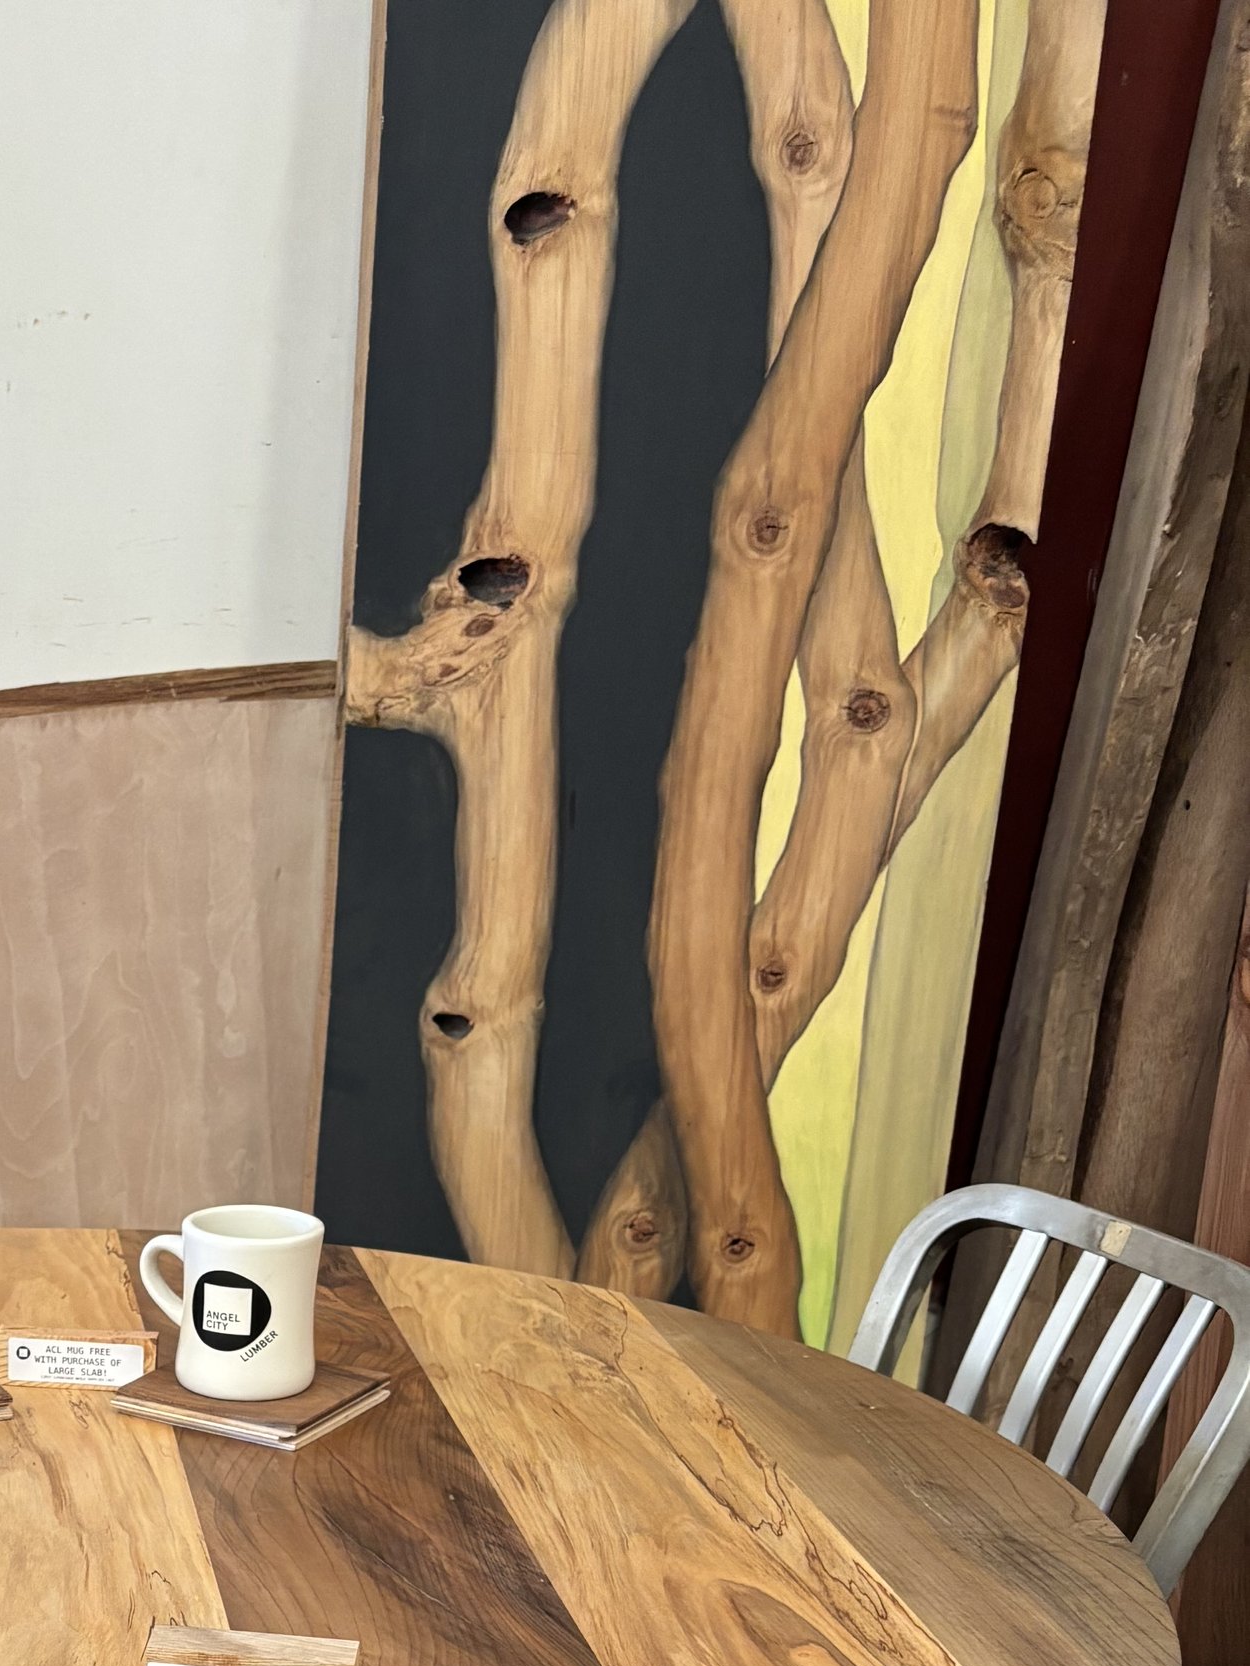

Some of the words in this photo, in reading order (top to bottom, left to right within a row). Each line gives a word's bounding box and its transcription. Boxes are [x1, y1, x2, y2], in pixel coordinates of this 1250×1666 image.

[206, 1310, 240, 1323] ANGEL
[206, 1320, 228, 1330] CITY
[46, 1346, 62, 1354] ACL
[67, 1347, 84, 1355] MUG
[89, 1348, 111, 1356] FREE
[240, 1330, 279, 1362] LUMBER
[34, 1356, 56, 1364] WITH
[62, 1357, 105, 1366] PURCHASE
[48, 1367, 75, 1375] LARGE
[81, 1368, 107, 1376] SLAB!
